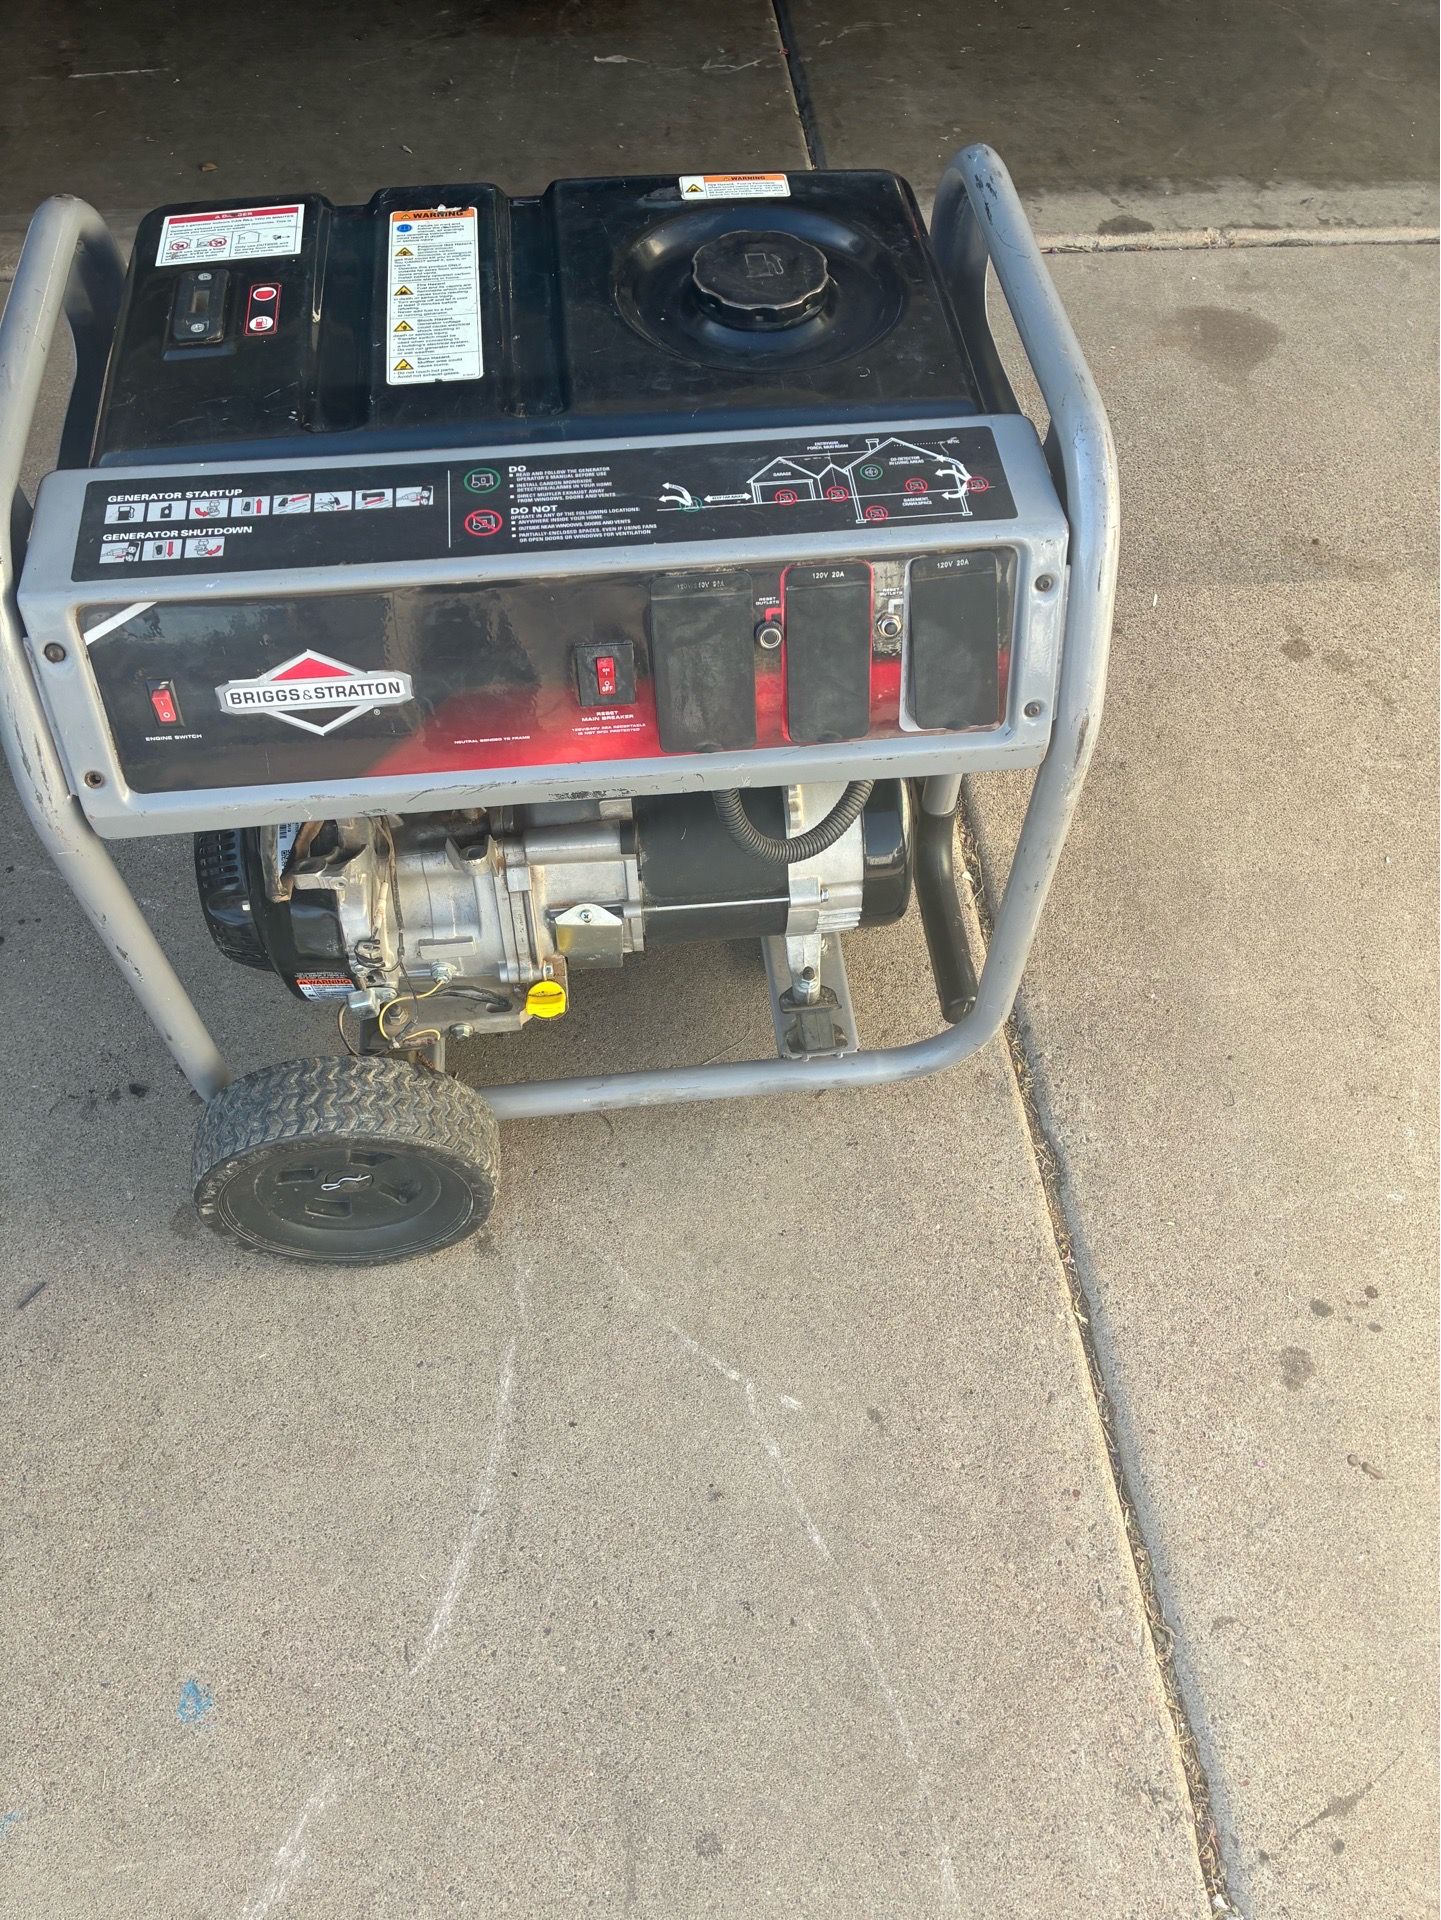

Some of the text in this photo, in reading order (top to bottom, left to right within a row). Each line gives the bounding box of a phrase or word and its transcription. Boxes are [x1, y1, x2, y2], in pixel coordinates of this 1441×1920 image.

[509, 465, 526, 473] DO
[108, 489, 243, 502] GENERATOR STARTUP
[511, 505, 558, 515] DO NOT
[102, 526, 252, 541] GENERATOR SHUTDOWN
[615, 529, 651, 537] VENTILATION
[937, 561, 953, 569] 120V
